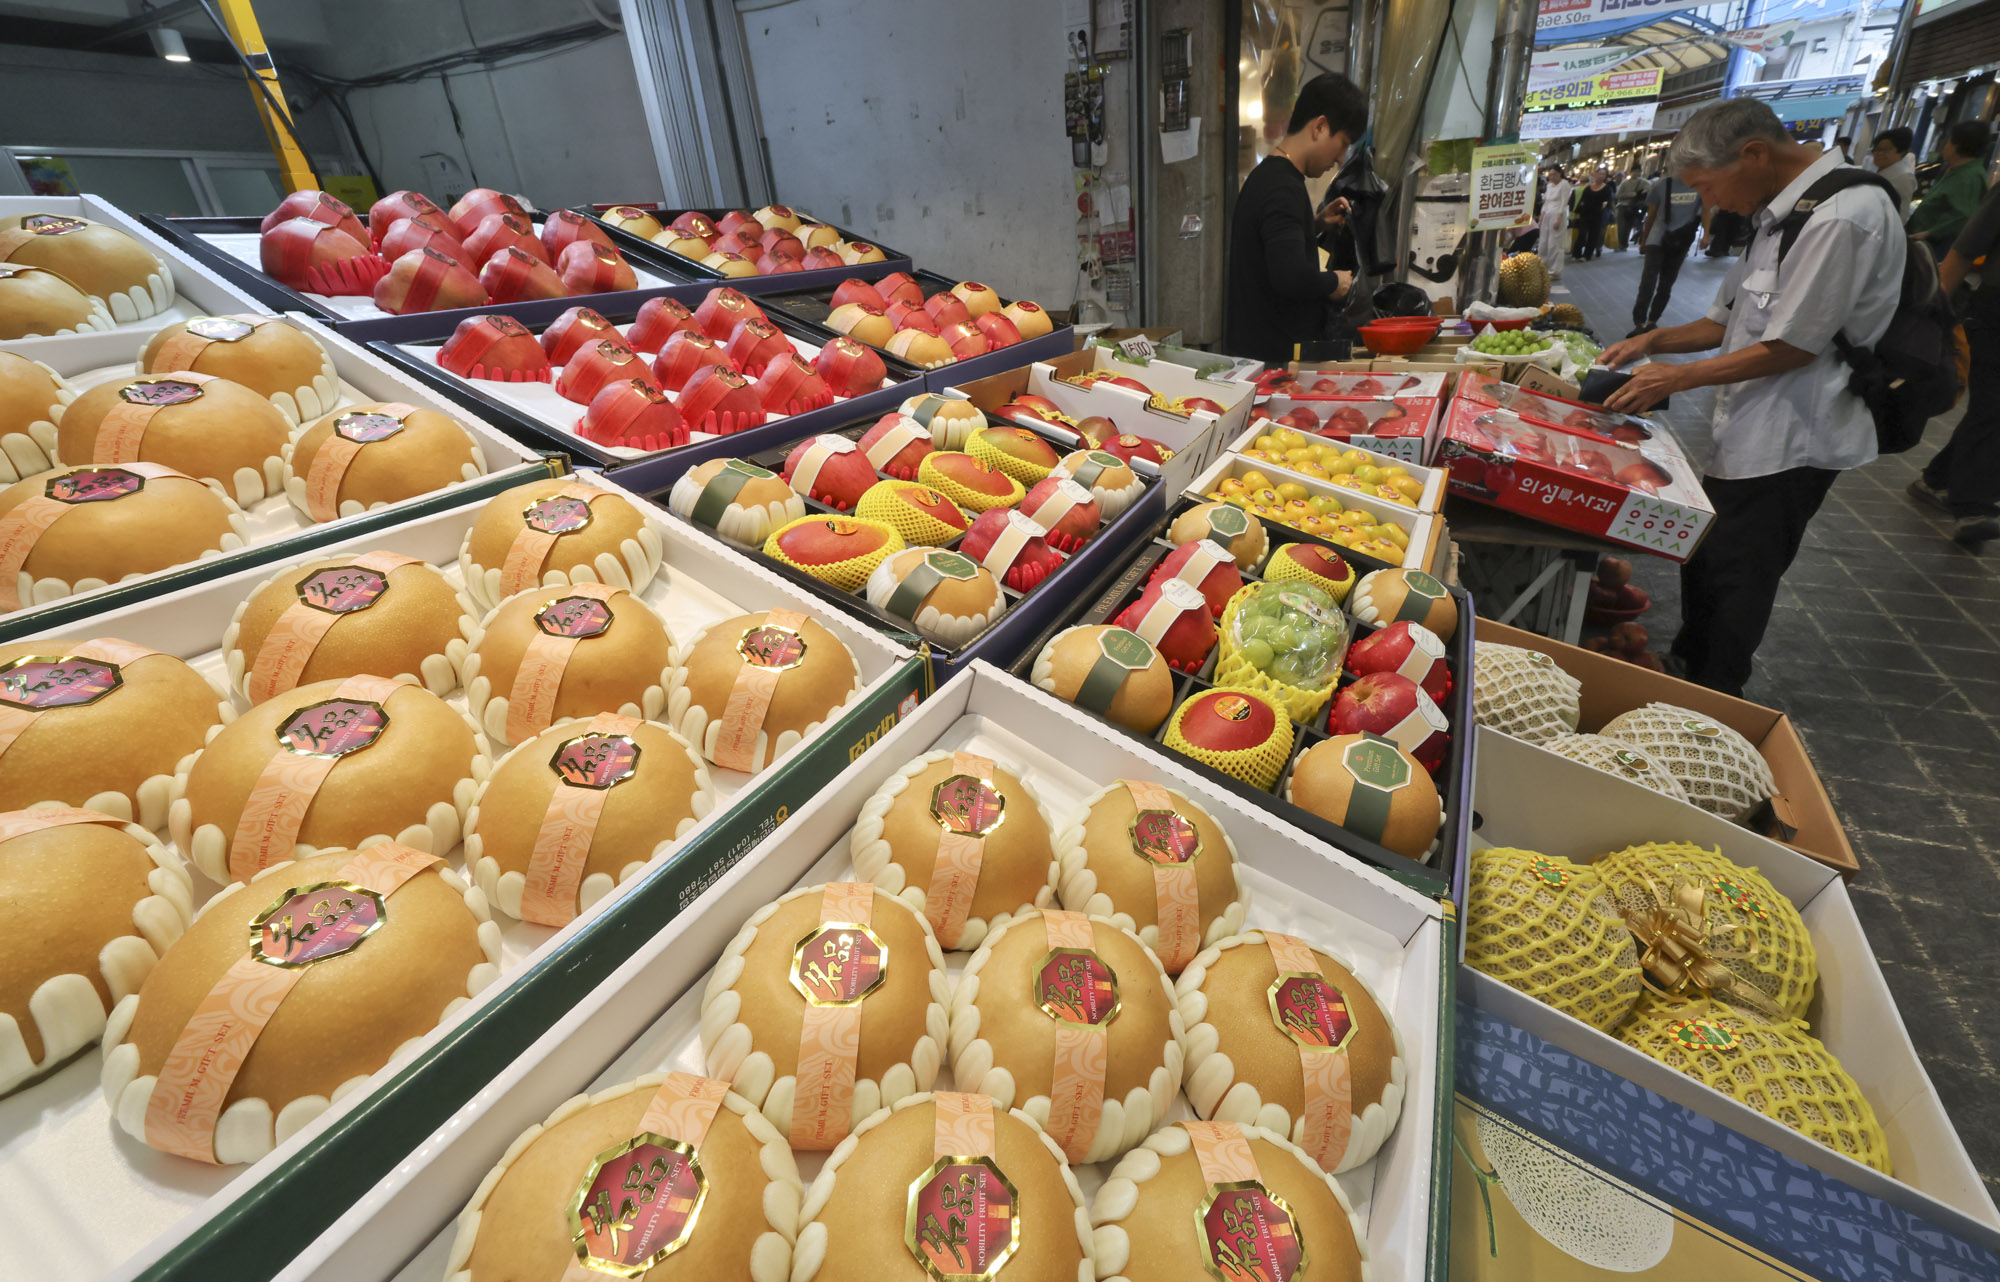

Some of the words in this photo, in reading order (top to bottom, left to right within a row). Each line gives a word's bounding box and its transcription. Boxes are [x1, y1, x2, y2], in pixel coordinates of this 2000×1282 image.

[1540, 80, 1594, 101] 신경외과
[1603, 86, 1658, 98] 02.966.8275
[1479, 190, 1526, 210] 참여점포
[1480, 171, 1527, 191] 환급행사
[1518, 476, 1560, 504] 의성
[1573, 493, 1617, 514] 사과
[1095, 582, 1129, 614] PREMIUM
[1125, 567, 1142, 582] GIFT
[1140, 556, 1152, 568] SET
[758, 815, 775, 830] TEL
[546, 864, 560, 898] PREMIUM
[557, 845, 567, 864] GIFT
[563, 827, 573, 842] SET
[728, 834, 750, 858] (041)
[678, 857, 725, 900] 581-7880
[268, 897, 357, 958] 名品
[303, 931, 336, 959] NOBILITY
[335, 914, 356, 933] FRUIT
[354, 901, 370, 916] SET
[804, 934, 854, 996] 名品
[850, 966, 858, 995] NOBILITY
[1086, 972, 1094, 990] FRUIT
[1046, 958, 1085, 1020] 名品
[1088, 990, 1098, 1020] NOBILITY
[1284, 982, 1324, 1042] 名品
[176, 1078, 202, 1126] PREMIUM
[198, 1047, 217, 1074] GIFT
[214, 1022, 232, 1044] SET
[824, 1060, 832, 1078] SET
[820, 1084, 830, 1106] GIFT
[586, 1155, 671, 1256] 名品
[634, 1212, 660, 1259] NOBILITY
[656, 1181, 674, 1209] FRUIT
[670, 1160, 684, 1179] SET
[921, 1173, 977, 1268] 名品
[1252, 1195, 1262, 1211] SET
[978, 1222, 986, 1266] NOBILITY
[1216, 1198, 1263, 1282] 名品
[1258, 1213, 1270, 1240] FRUIT
[1266, 1242, 1285, 1282] NOBILITY
